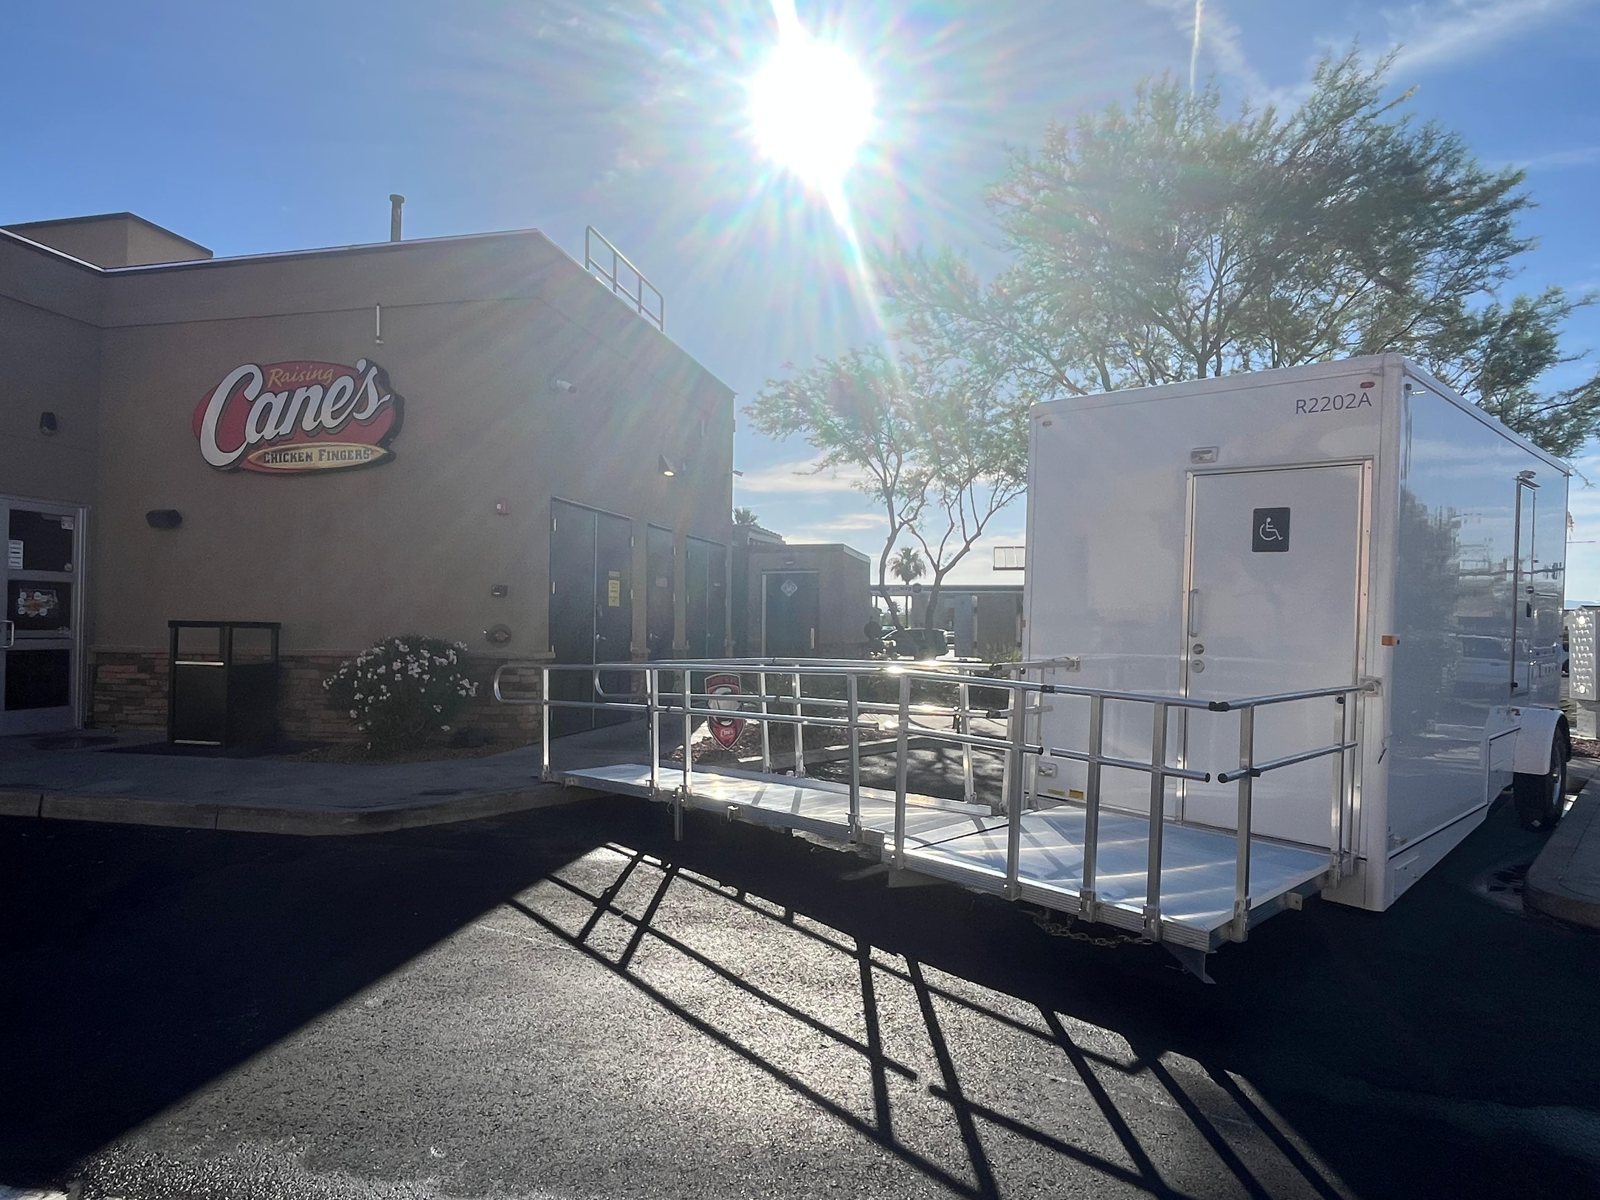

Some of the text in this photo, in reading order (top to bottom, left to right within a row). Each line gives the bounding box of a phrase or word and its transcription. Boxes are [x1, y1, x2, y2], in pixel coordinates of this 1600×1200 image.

[267, 365, 336, 388] Raising
[200, 358, 391, 467] Cane's
[1295, 391, 1372, 415] R2202A
[263, 448, 371, 464] CHICKEN FINGERS
